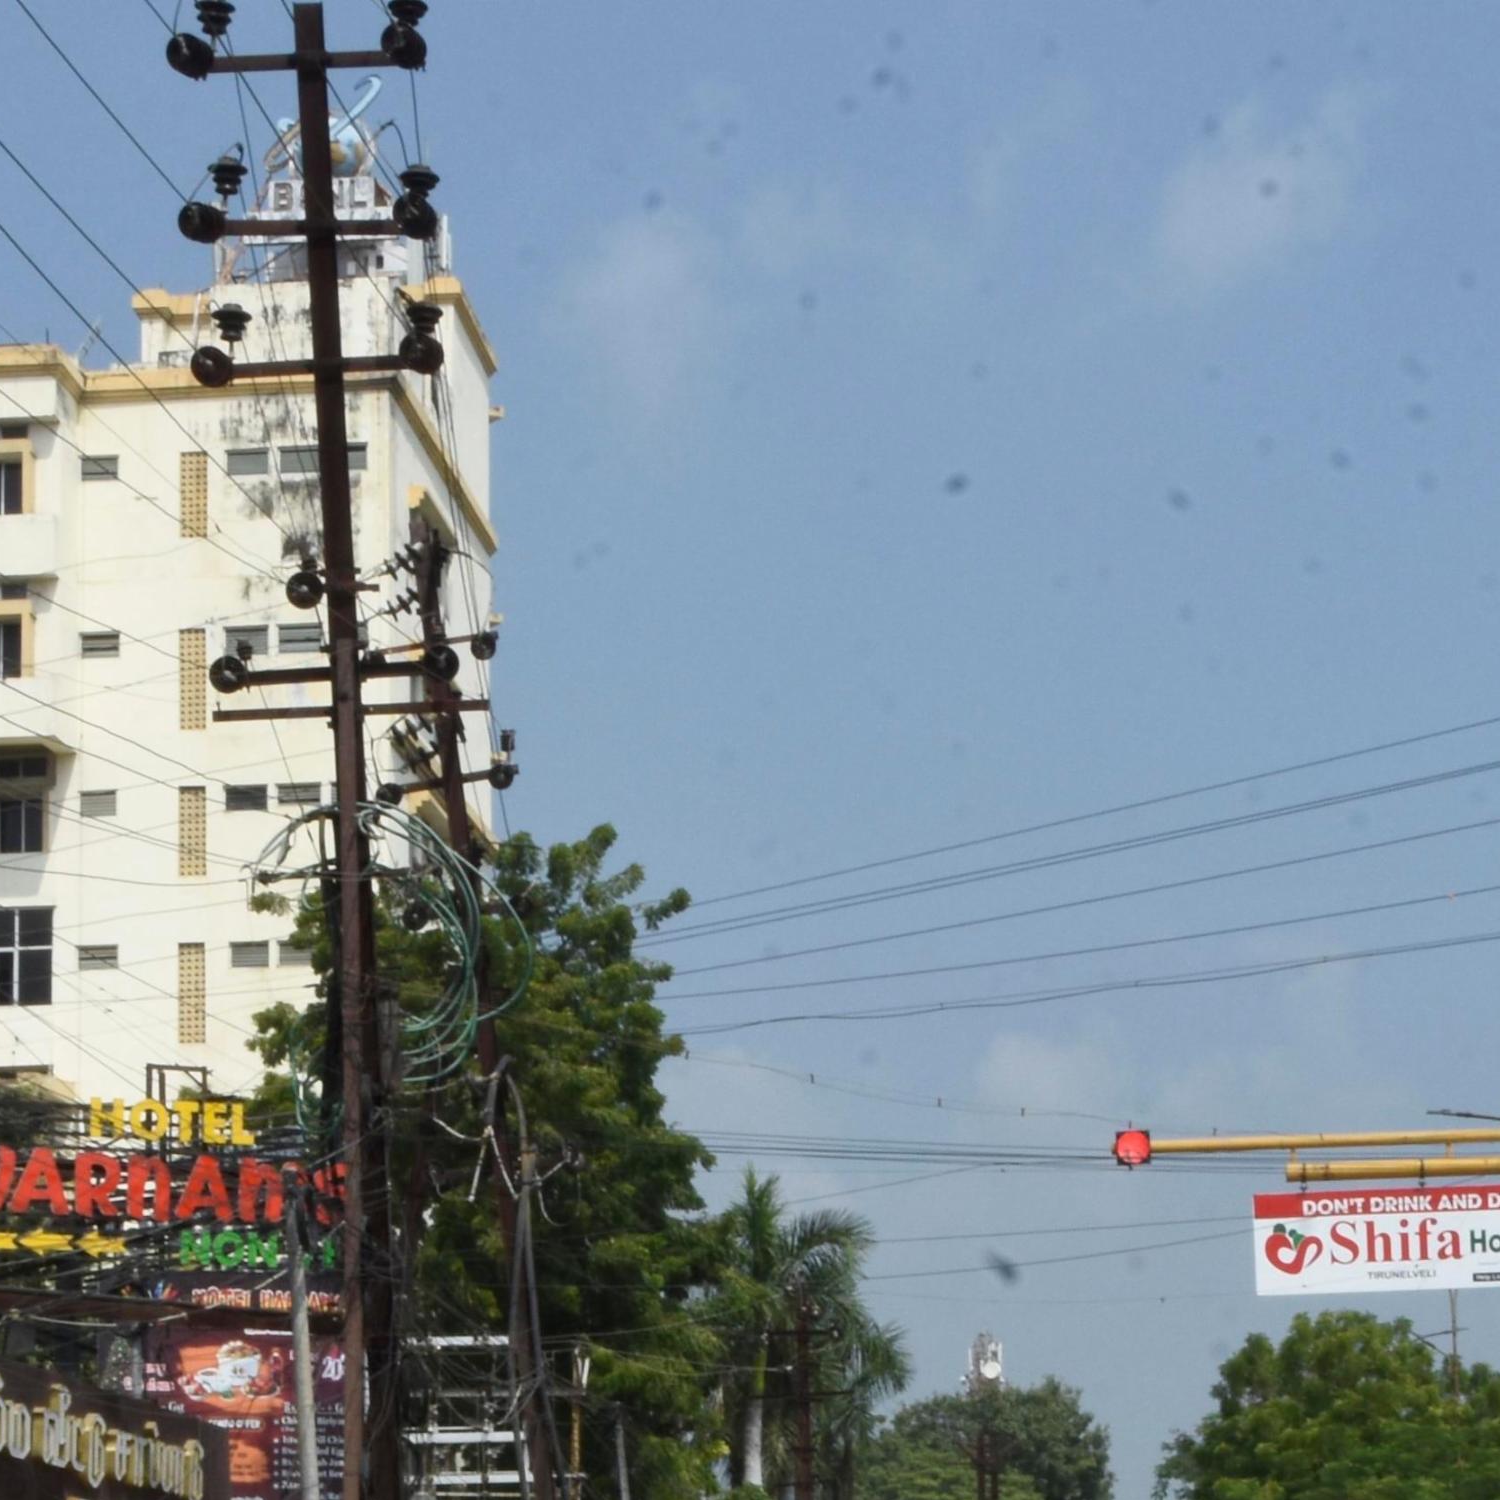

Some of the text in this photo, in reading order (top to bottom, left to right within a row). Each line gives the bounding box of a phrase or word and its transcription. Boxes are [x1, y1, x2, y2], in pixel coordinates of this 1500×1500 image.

[89, 1097, 255, 1146] HOTEL
[1302, 1197, 1365, 1217] DON'T
[1370, 1196, 1431, 1213] DRINK
[1441, 1194, 1482, 1210] AND
[1330, 1217, 1464, 1265] Shifa
[1367, 1269, 1437, 1280] TIRUNELVELI
